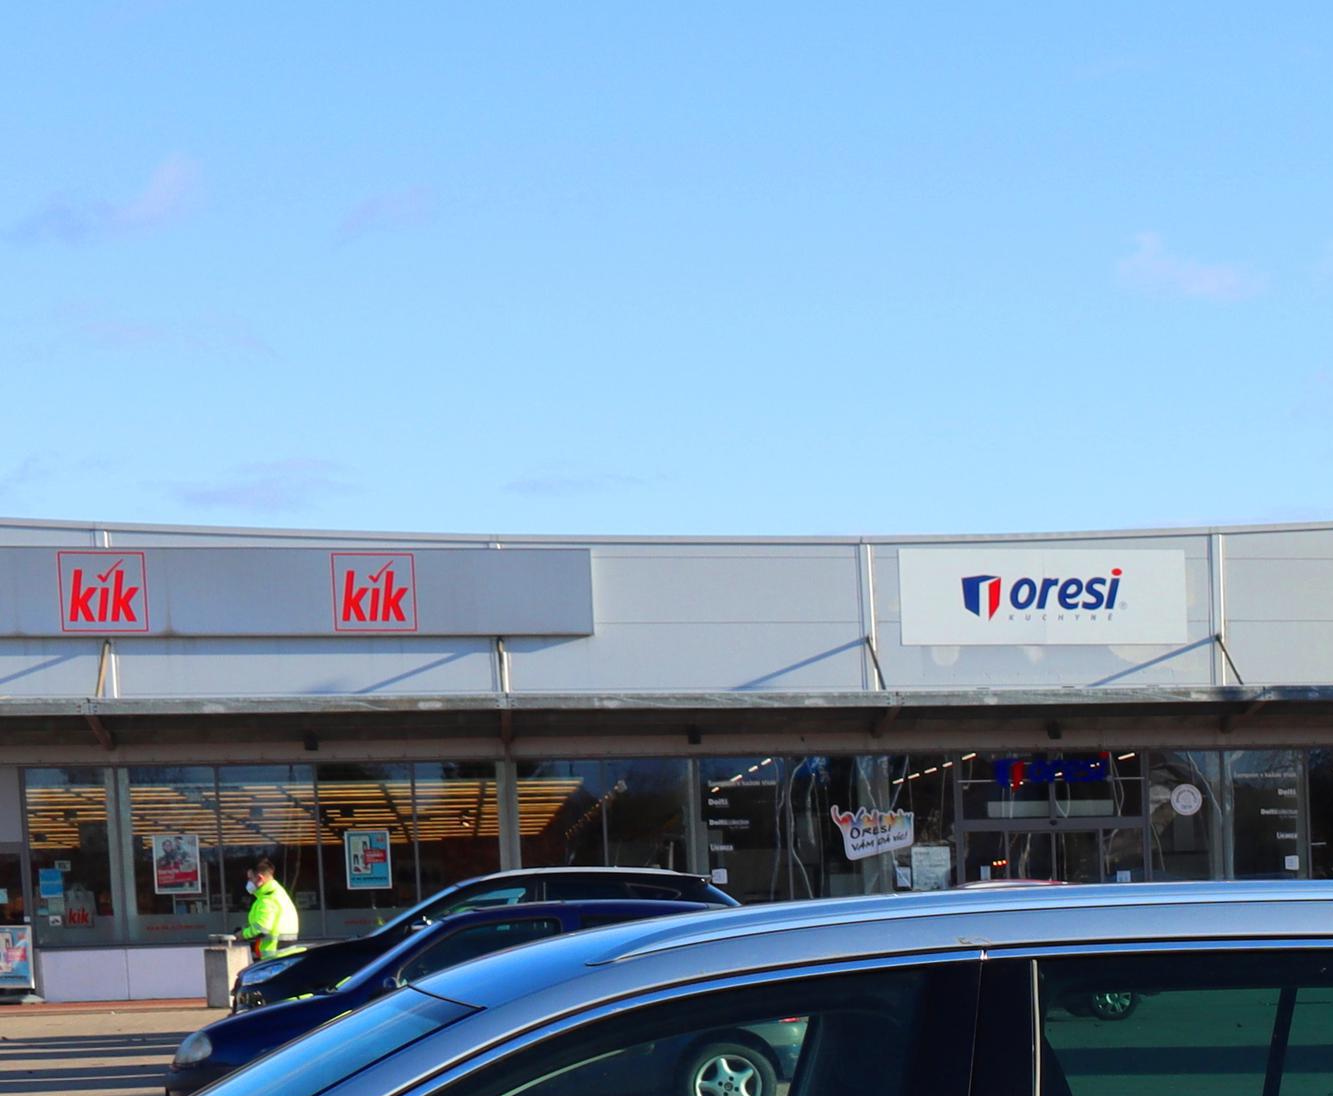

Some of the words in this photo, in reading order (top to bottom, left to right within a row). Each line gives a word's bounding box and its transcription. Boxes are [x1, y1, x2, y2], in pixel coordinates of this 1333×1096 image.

[69, 560, 139, 622] kik
[342, 560, 408, 622] kik
[1009, 568, 1122, 610] oresi
[850, 824, 892, 840] ORESI
